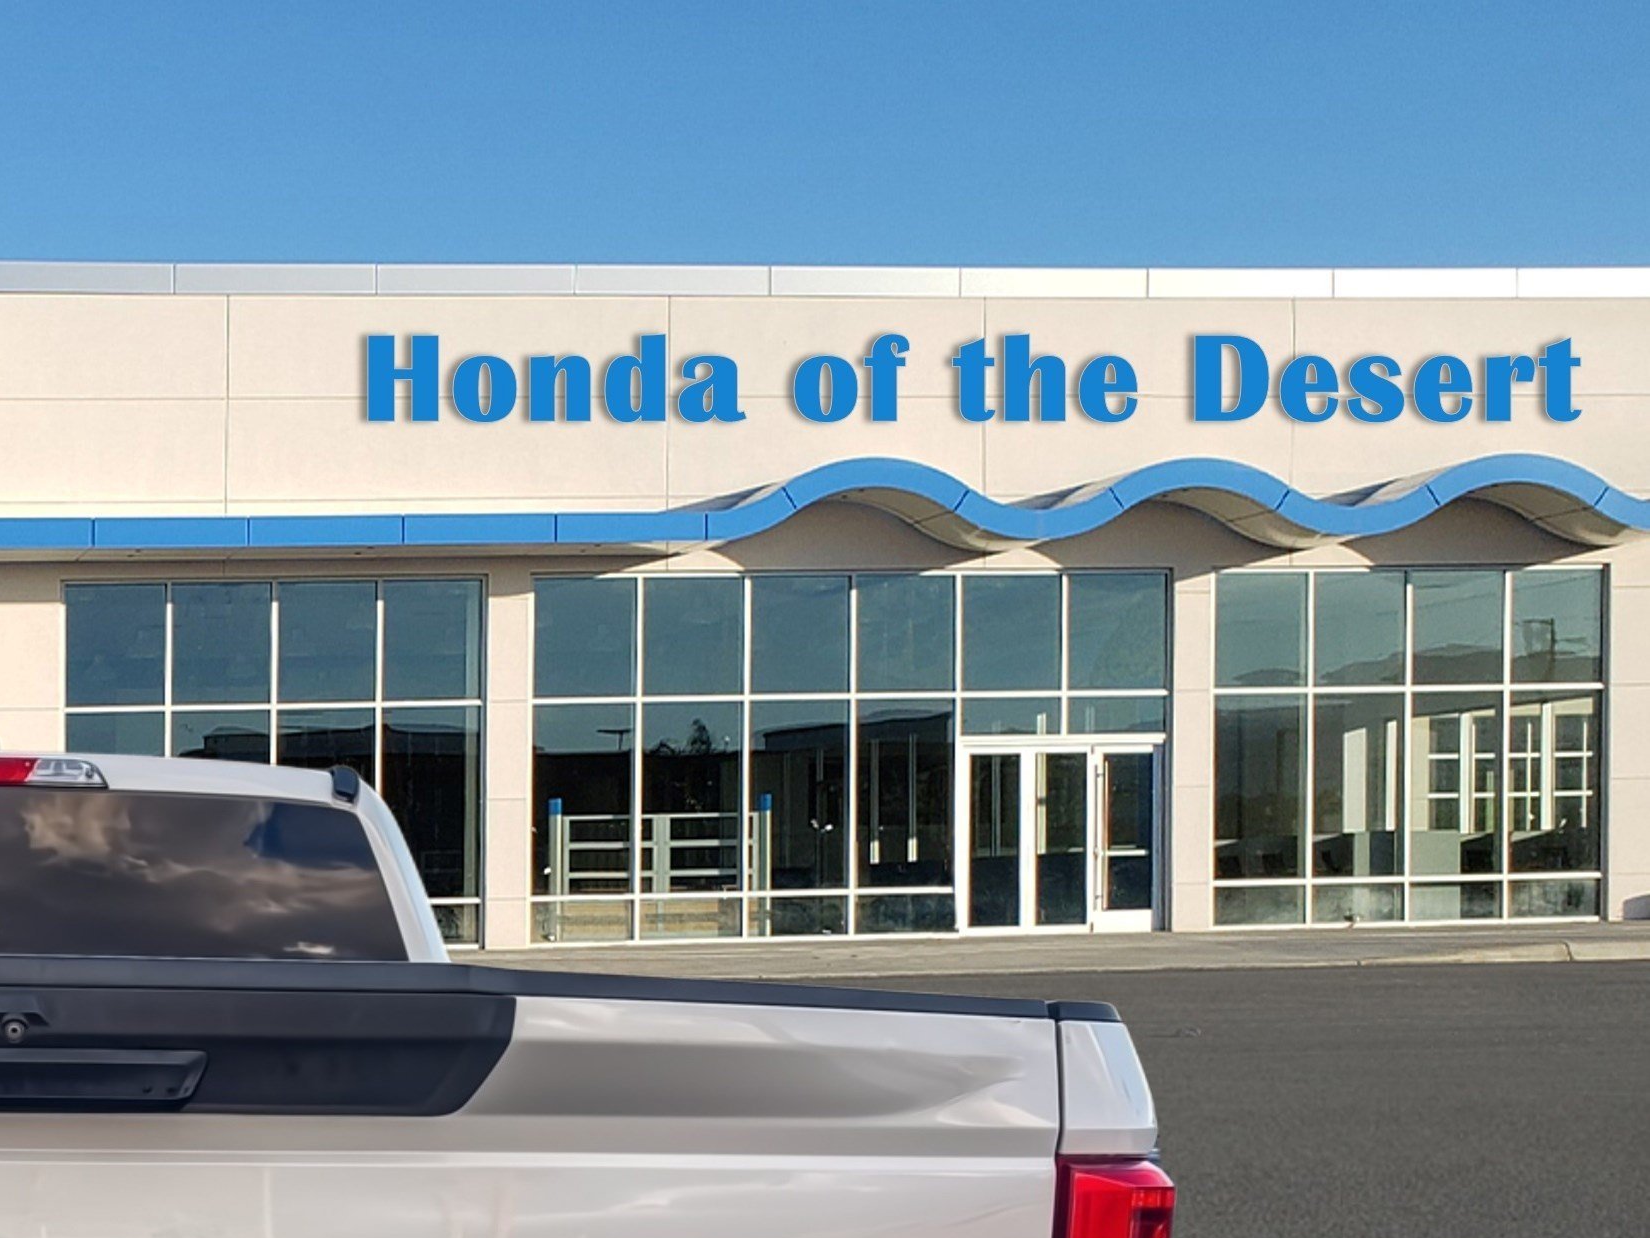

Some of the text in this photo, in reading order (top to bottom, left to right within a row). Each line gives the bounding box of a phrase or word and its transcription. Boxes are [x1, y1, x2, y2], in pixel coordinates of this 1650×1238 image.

[364, 333, 1582, 423] Honda of the Desert
